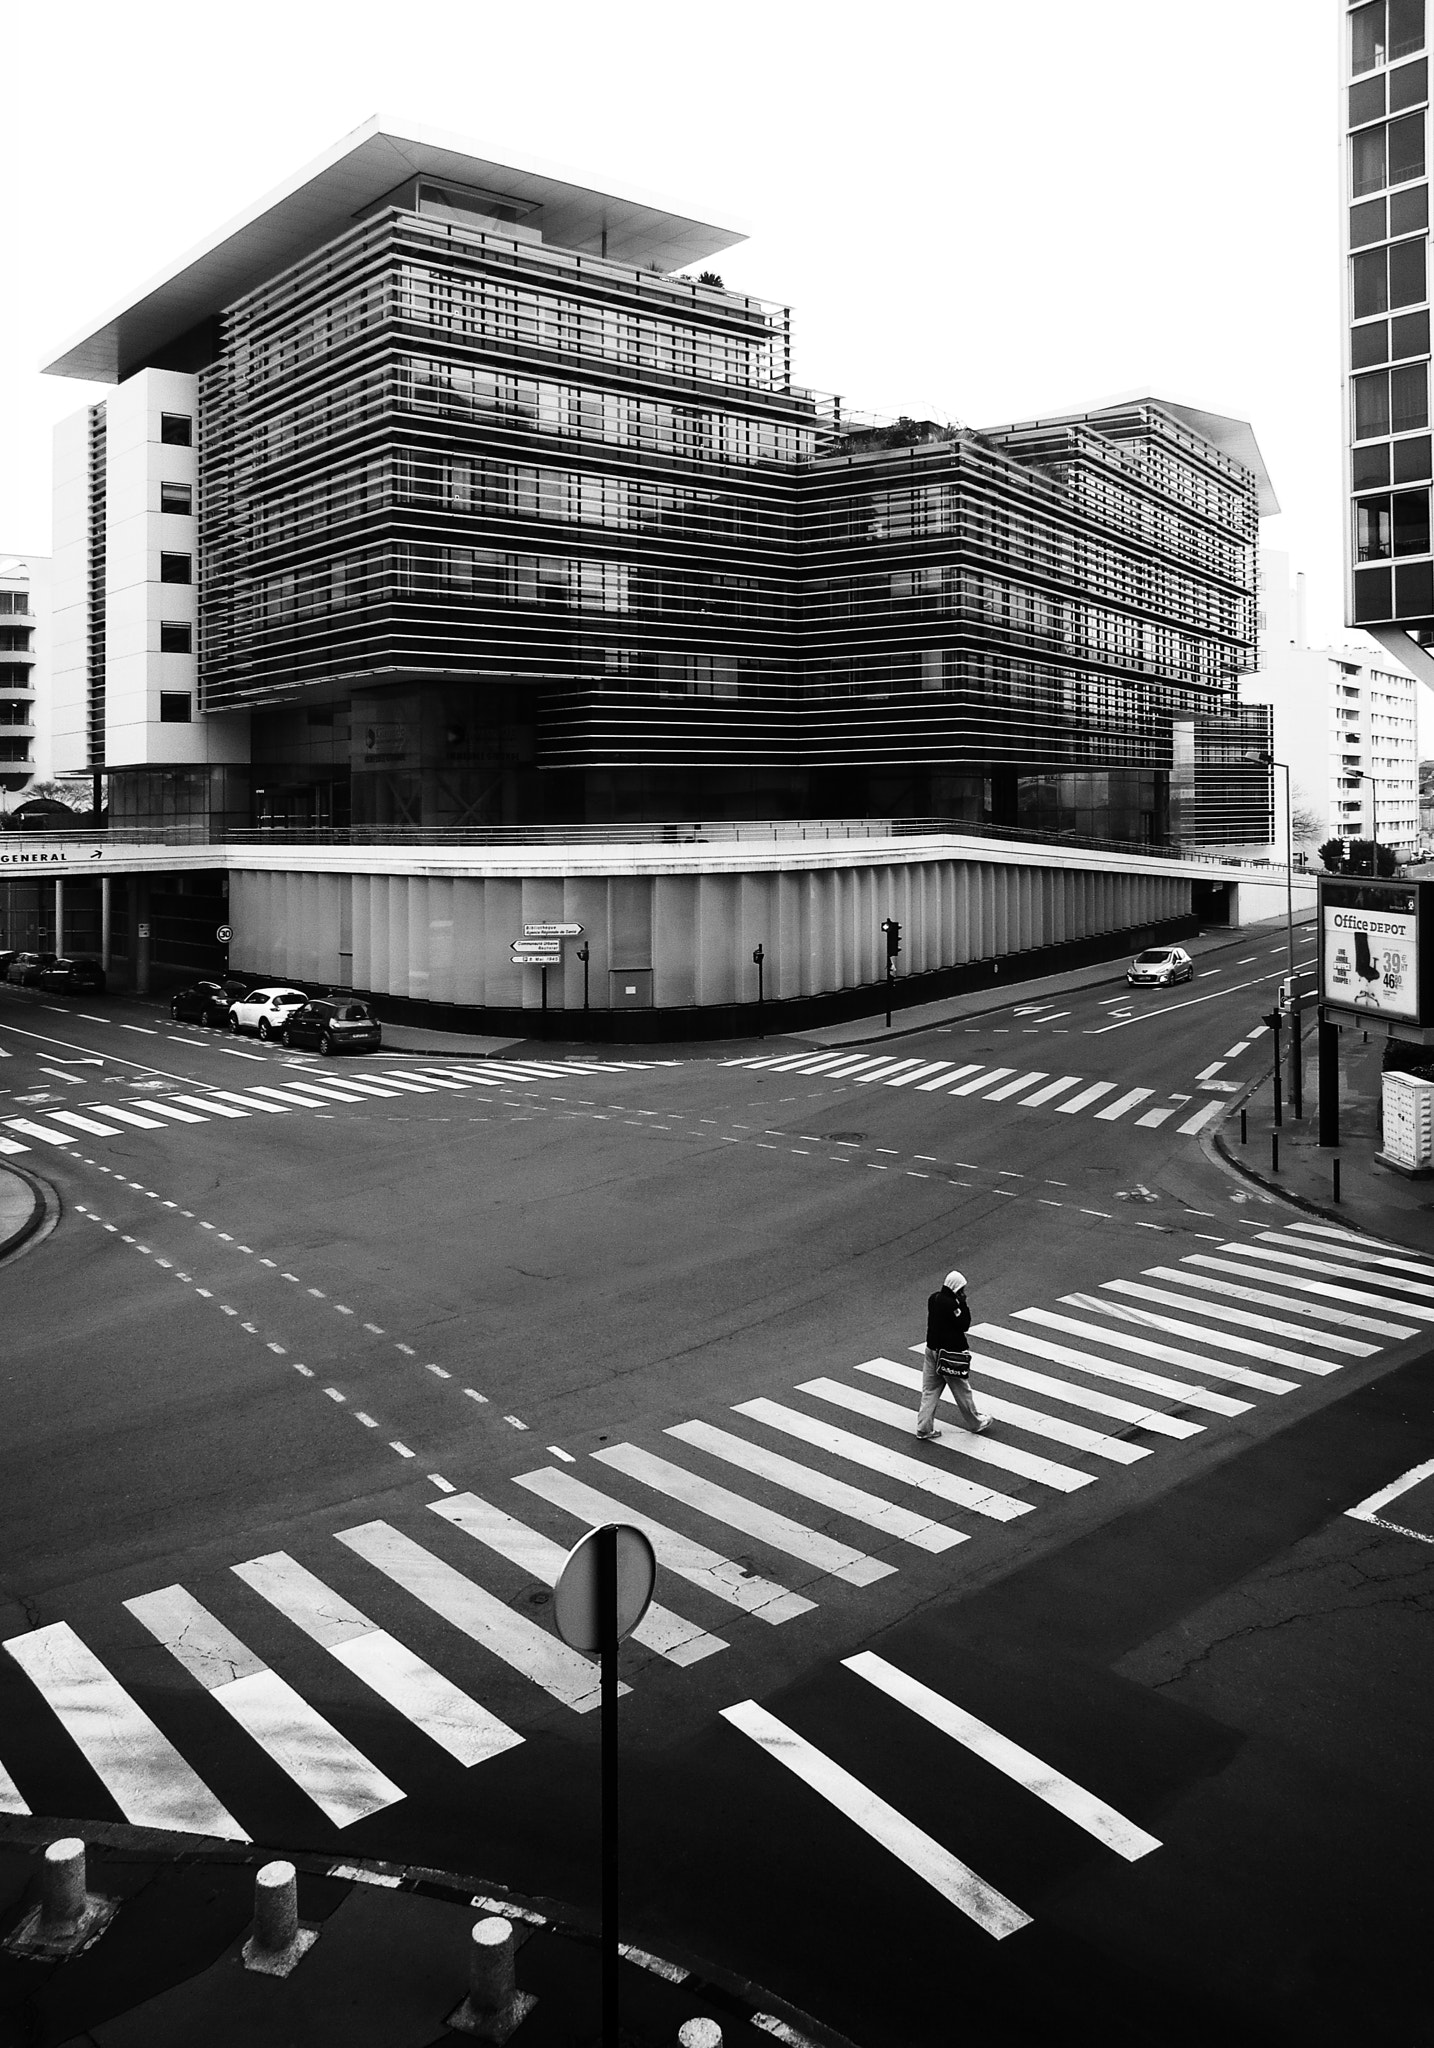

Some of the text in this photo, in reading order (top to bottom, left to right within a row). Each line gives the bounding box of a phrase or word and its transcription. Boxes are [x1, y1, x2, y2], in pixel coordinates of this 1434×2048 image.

[1, 853, 67, 862] GENERAL
[1334, 913, 1407, 936] Office DEPOT
[220, 930, 231, 938] 30
[1383, 951, 1401, 974] 39
[1383, 973, 1395, 989] 46
[941, 1366, 961, 1375] adidas
